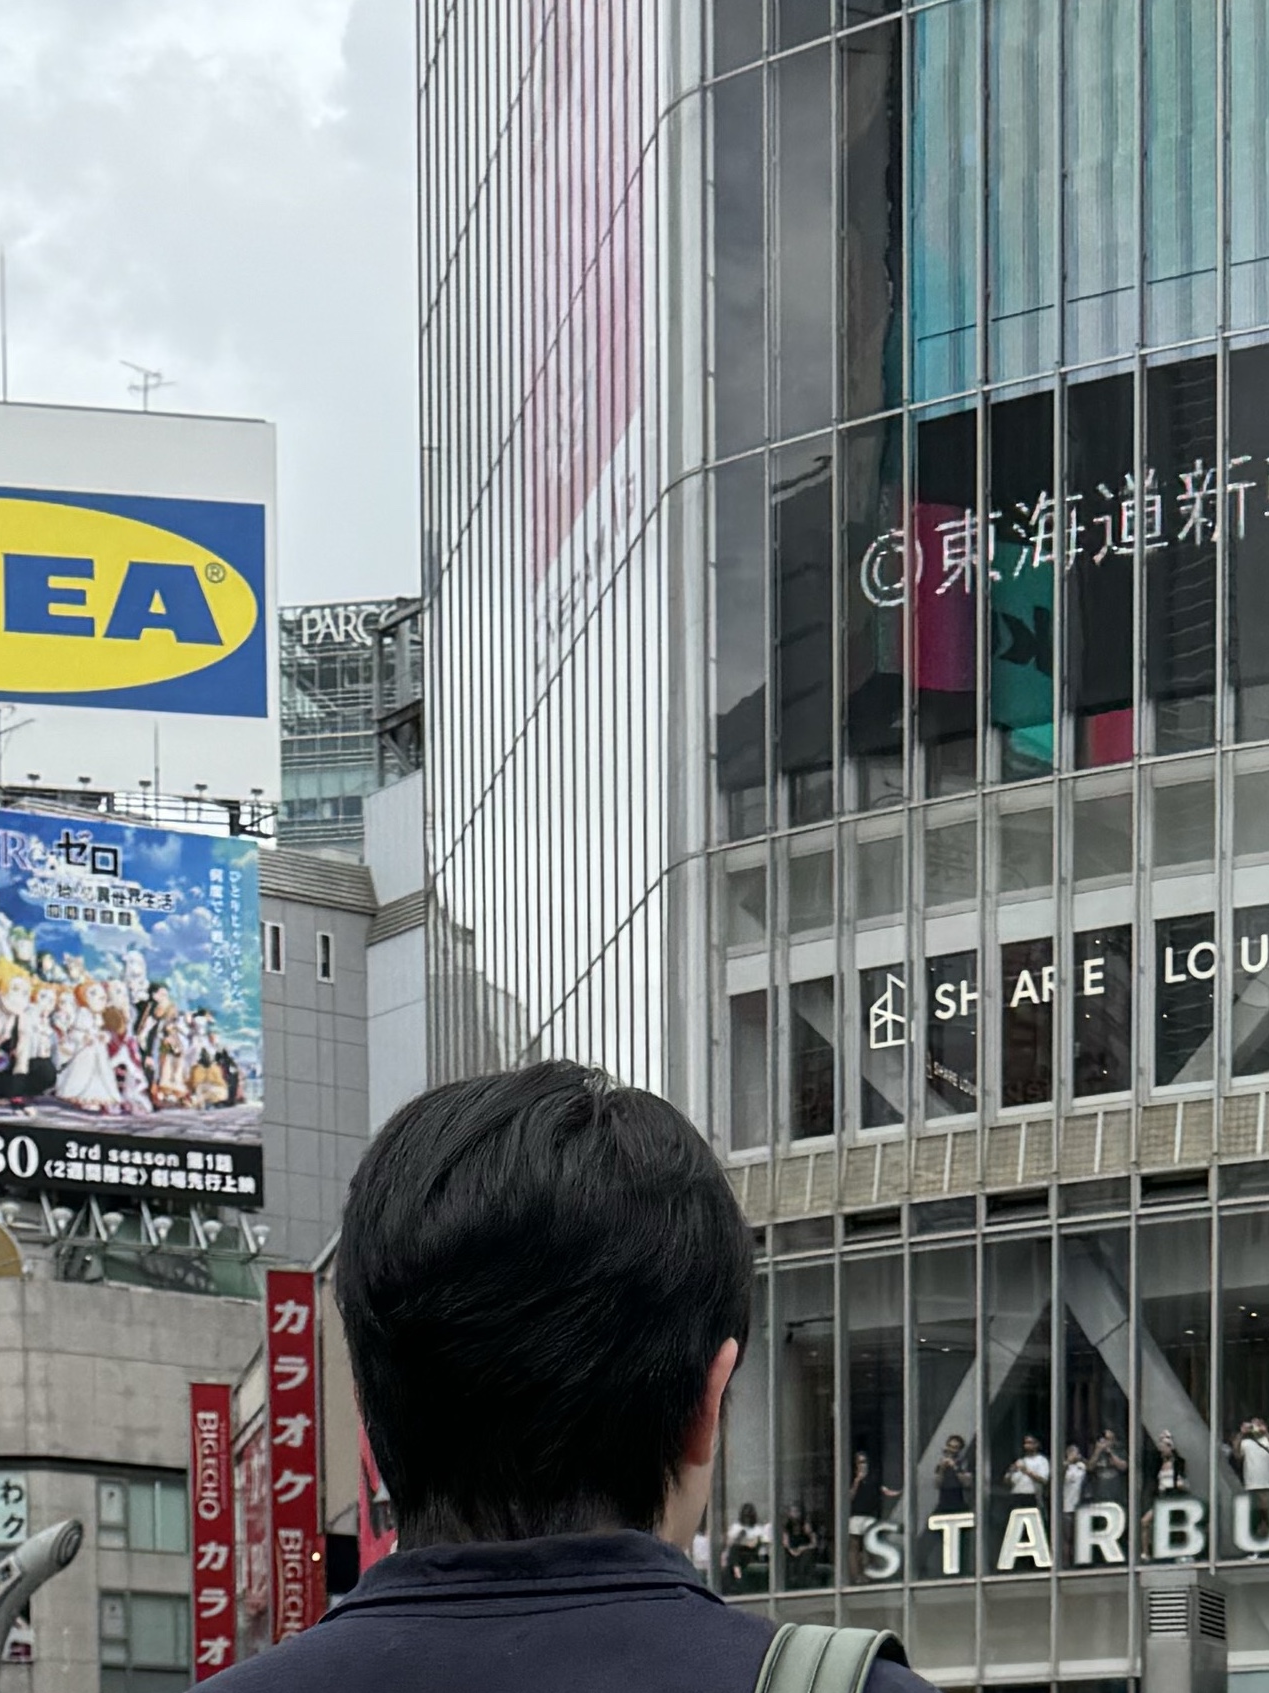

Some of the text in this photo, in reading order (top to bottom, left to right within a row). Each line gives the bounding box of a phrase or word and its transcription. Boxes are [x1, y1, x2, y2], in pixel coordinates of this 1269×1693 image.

[65, 1141, 101, 1160] 3rd
[108, 1147, 180, 1168] season
[273, 1299, 313, 1503] カラオケ
